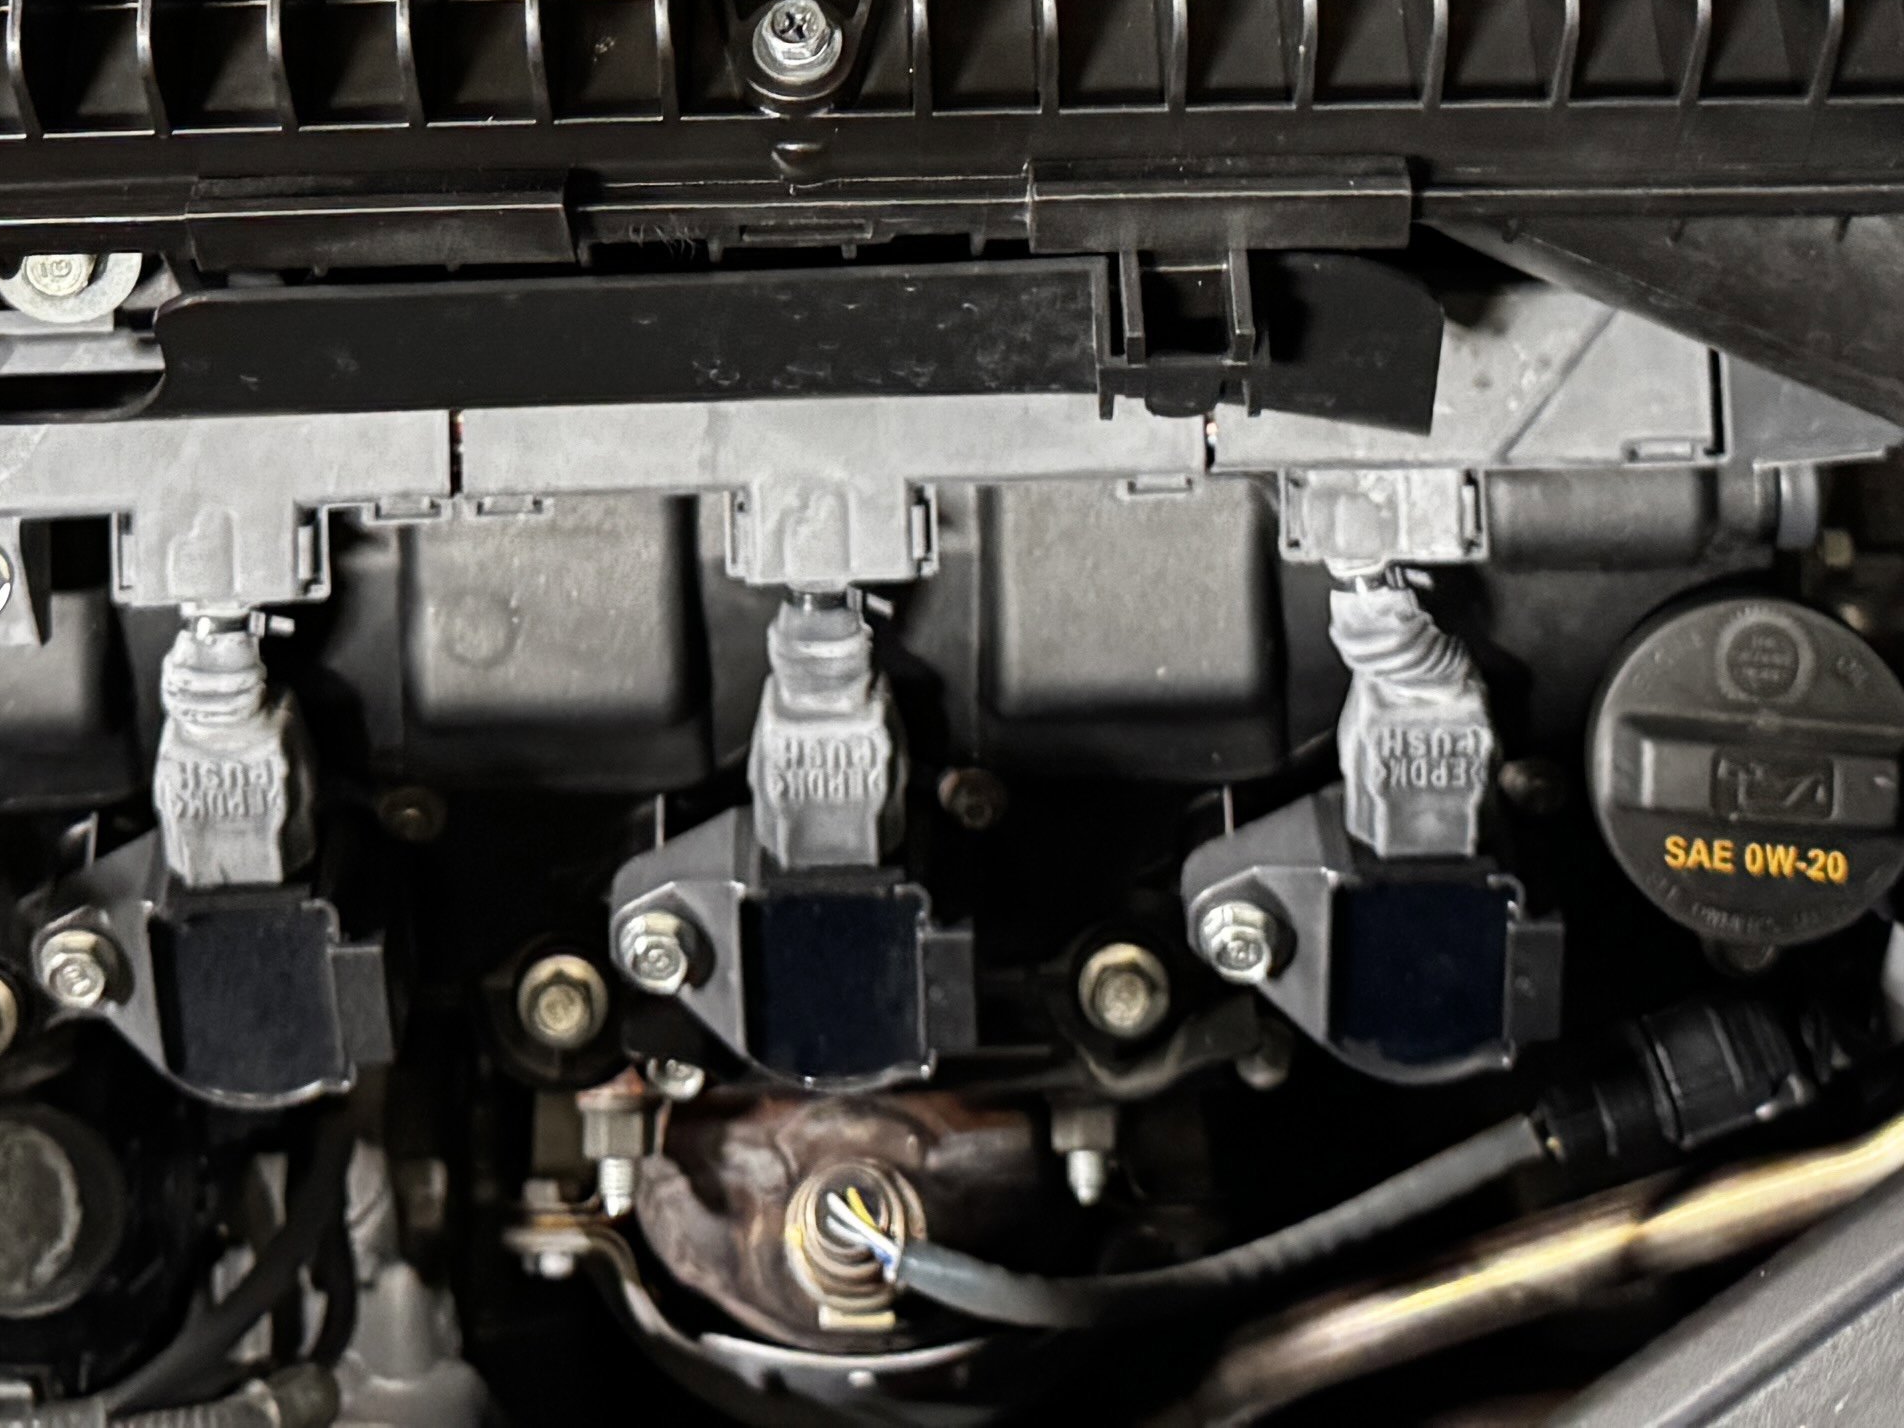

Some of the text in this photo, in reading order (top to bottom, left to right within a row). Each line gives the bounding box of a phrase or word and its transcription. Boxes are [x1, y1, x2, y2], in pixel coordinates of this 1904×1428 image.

[1379, 727, 1484, 758] PUSH
[1664, 834, 1849, 885] SAE 0W-20
